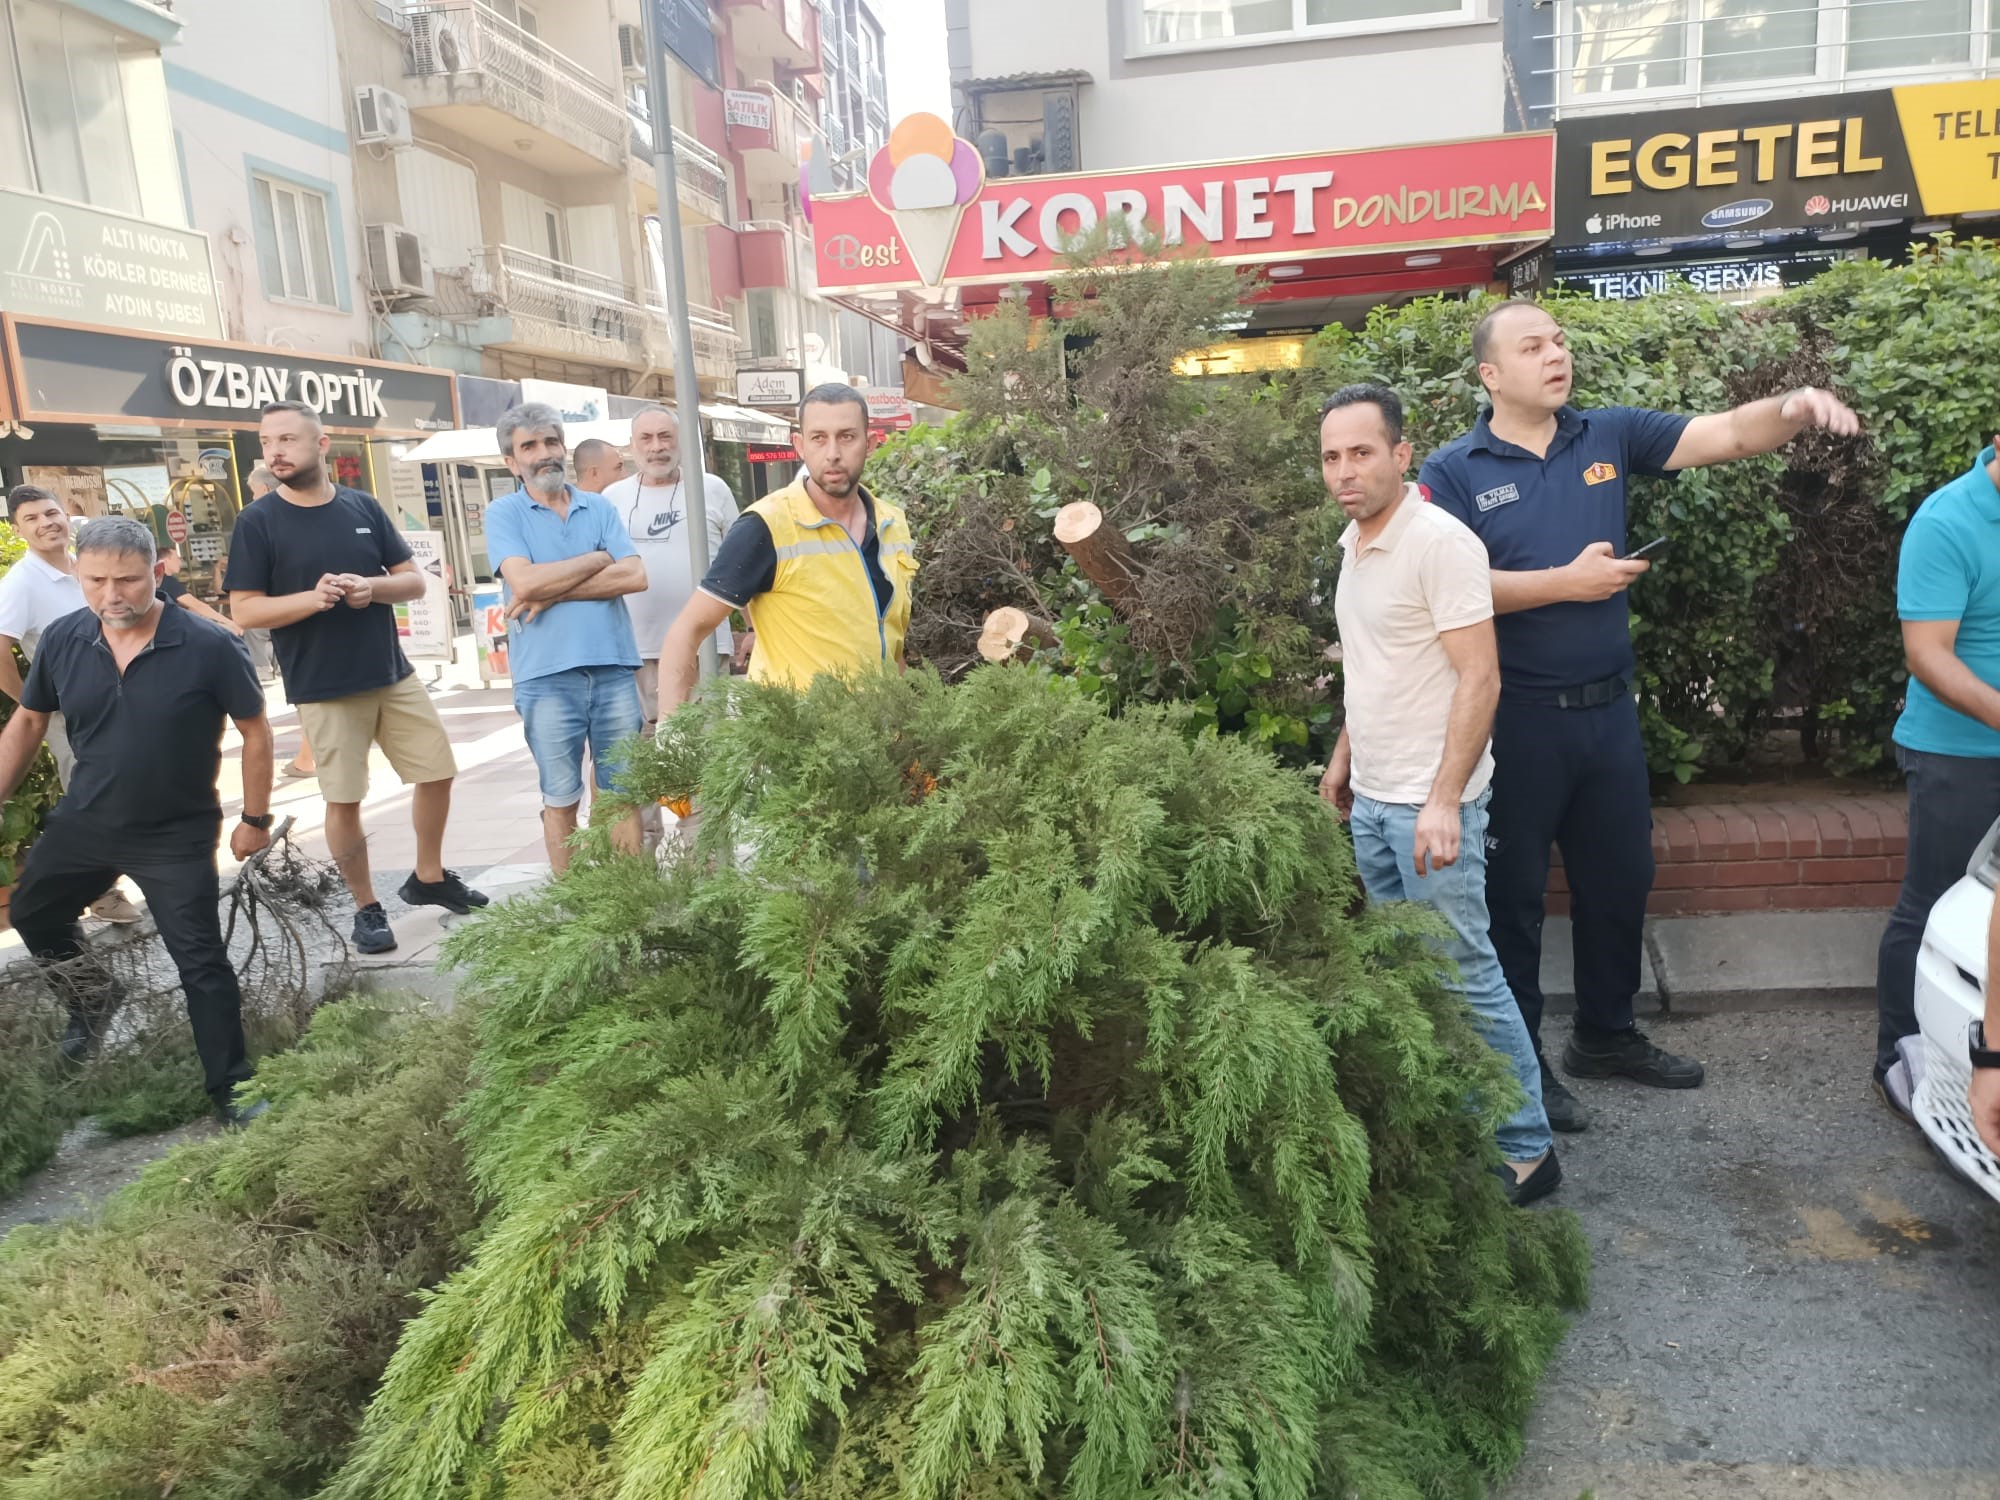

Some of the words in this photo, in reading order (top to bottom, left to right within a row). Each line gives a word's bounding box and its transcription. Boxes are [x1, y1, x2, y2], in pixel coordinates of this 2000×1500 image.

[1590, 116, 1883, 197] EGETEL
[979, 170, 1334, 261] KORNET
[1333, 180, 1547, 231] DONDURMA
[1710, 204, 1765, 220] SAMSUNG
[1831, 193, 1909, 213] HUAWEI
[1605, 212, 1662, 231] iPhone
[102, 225, 135, 251] ALTI
[138, 233, 189, 260] NOKTA
[823, 233, 902, 271] Best
[83, 253, 148, 285] KÖRLER
[150, 268, 211, 296] DERNEĞİ
[1689, 263, 1780, 293] SERVİS
[105, 293, 153, 318] AYDIN
[156, 300, 206, 327] ŞUBESİ
[168, 346, 289, 410] ÖZBAY
[298, 369, 388, 418] OPTİK
[752, 376, 785, 393] Adem
[653, 510, 681, 526] NIKE
